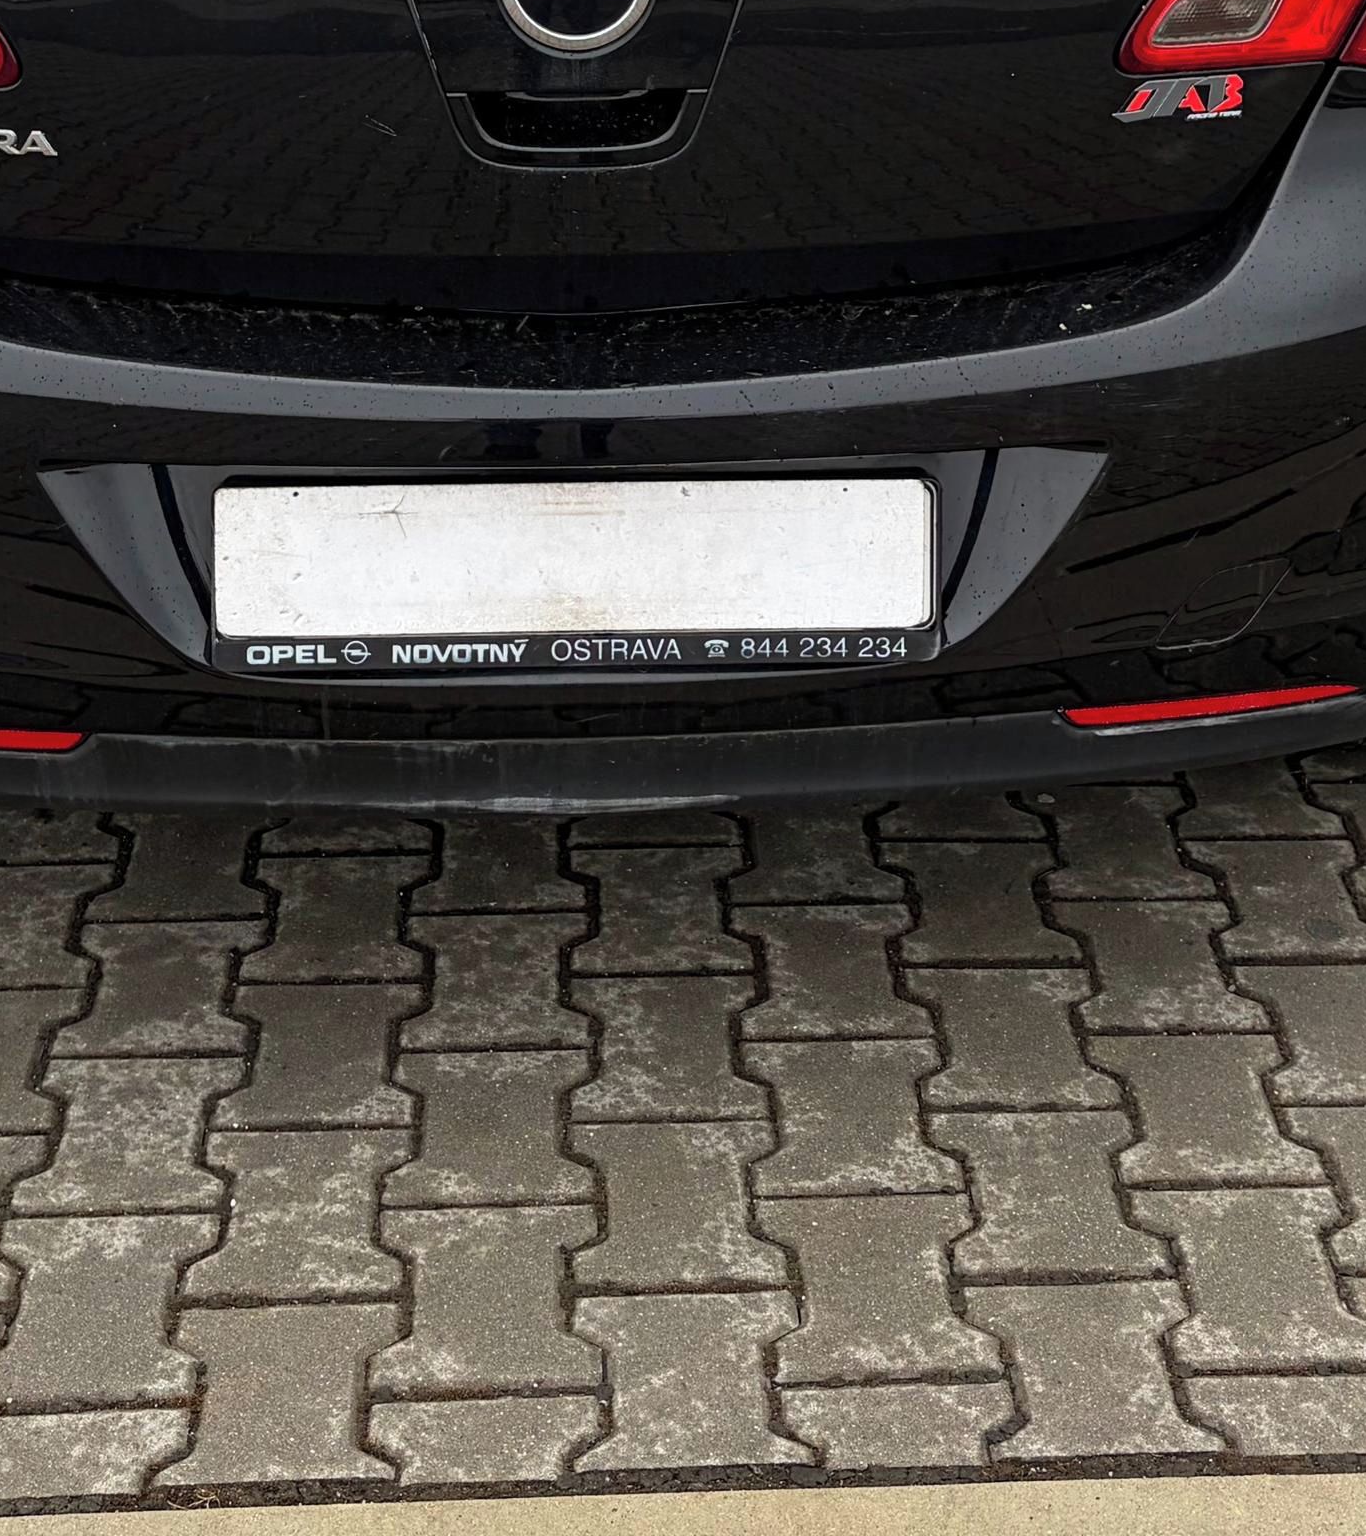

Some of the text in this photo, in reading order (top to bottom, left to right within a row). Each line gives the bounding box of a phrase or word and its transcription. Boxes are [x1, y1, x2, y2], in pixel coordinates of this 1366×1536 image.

[246, 636, 908, 665] OPEL NOVOTNÝ OSTRAVA 844 234 234
